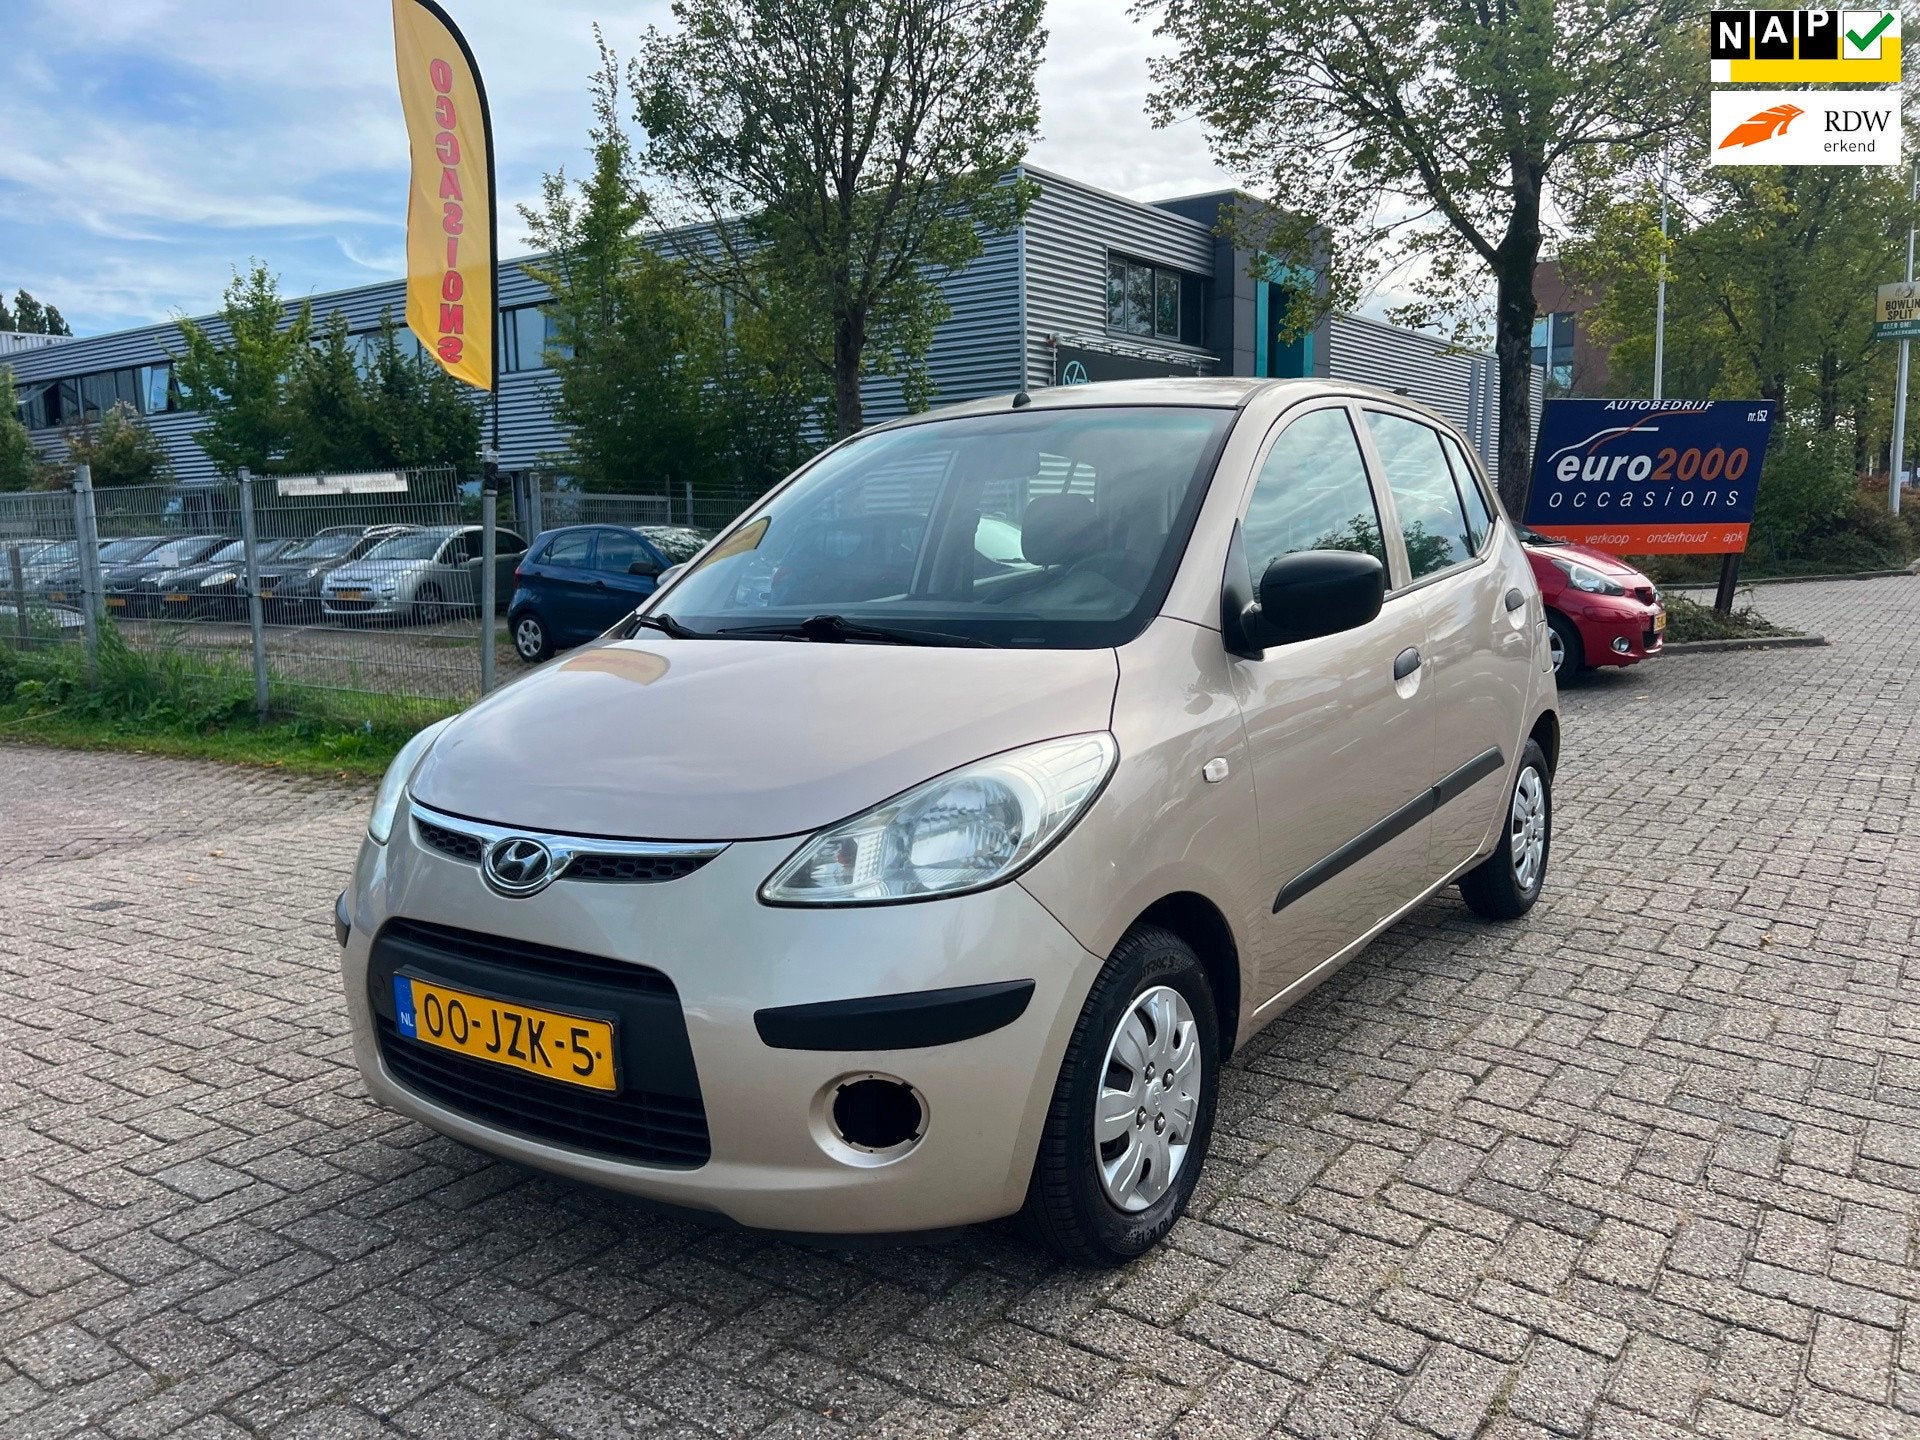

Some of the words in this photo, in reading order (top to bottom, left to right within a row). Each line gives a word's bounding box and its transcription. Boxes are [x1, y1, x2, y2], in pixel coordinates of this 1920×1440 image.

[1888, 310, 1913, 320] SPLIT
[1604, 400, 1715, 411] AUTOBEDRIJF
[1556, 447, 1749, 482] euro2000
[1549, 486, 1739, 508] occasions
[1585, 533, 1630, 545] verkoop
[1647, 531, 1709, 544] onderhoud
[1723, 531, 1743, 543] apk
[400, 1010, 414, 1027] NL
[423, 992, 596, 1077] 00-JZK-5
